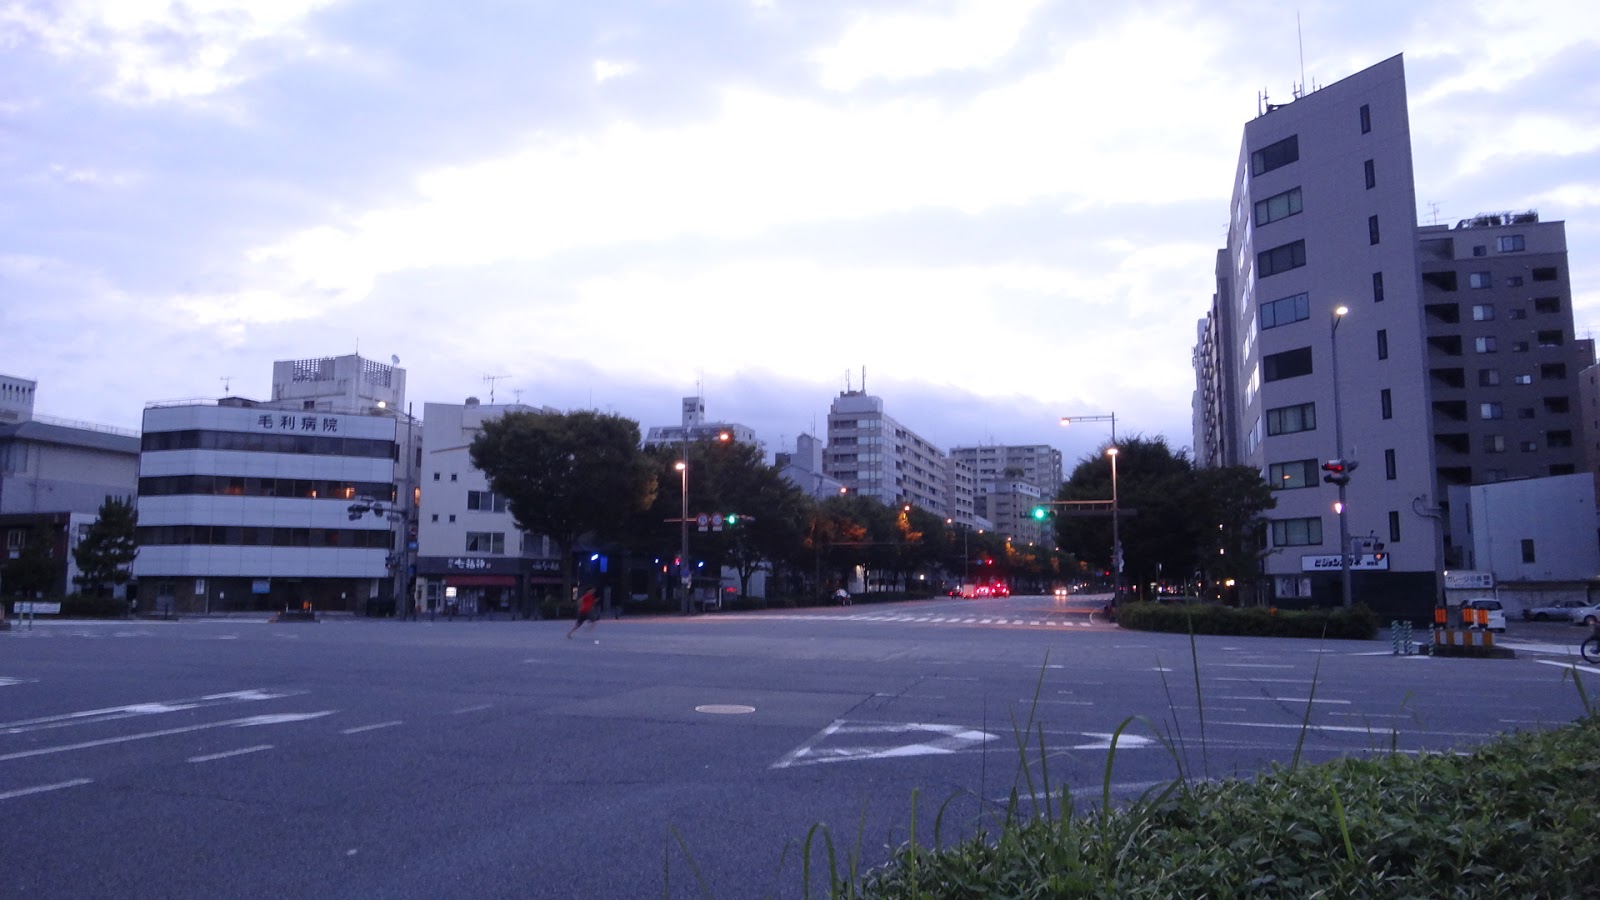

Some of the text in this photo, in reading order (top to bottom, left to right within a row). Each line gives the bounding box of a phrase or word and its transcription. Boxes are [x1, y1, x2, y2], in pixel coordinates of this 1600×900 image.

[257, 414, 338, 433] 毛利病院
[1315, 557, 1361, 568] ビジョンガネ
